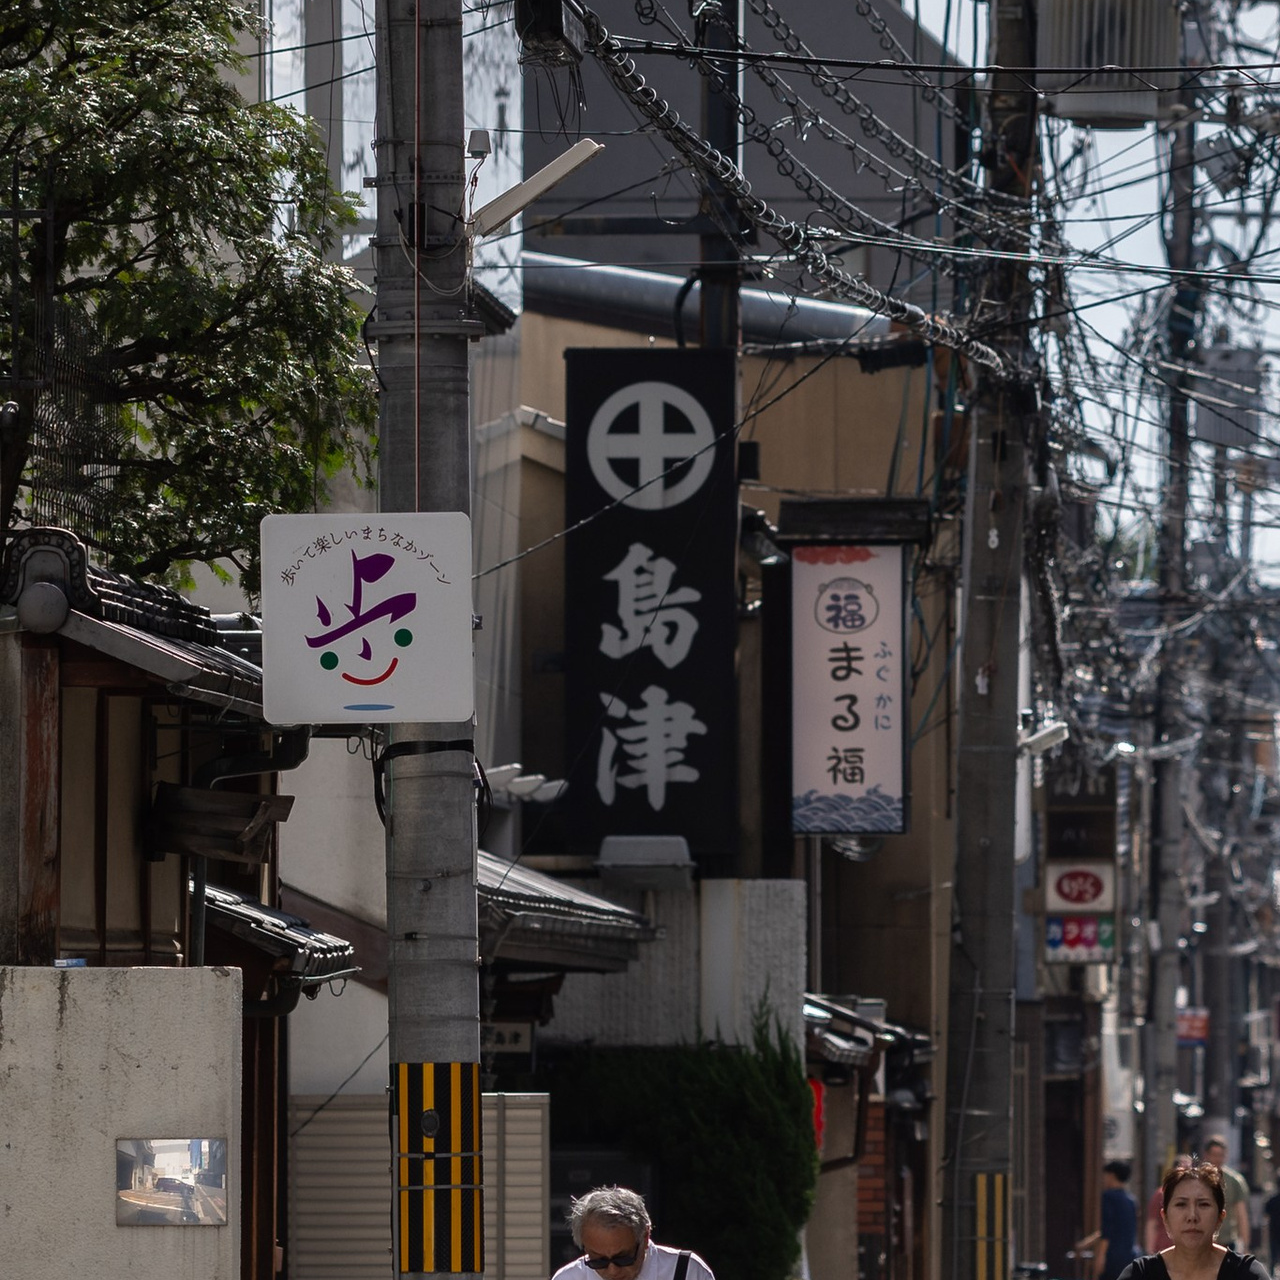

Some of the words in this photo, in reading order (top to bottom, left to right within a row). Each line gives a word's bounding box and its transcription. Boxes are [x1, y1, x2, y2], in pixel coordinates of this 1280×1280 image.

[280, 525, 451, 587] 歩いて楽しいまちなかゾーン
[596, 542, 707, 811] 島津
[827, 641, 865, 785] まる福
